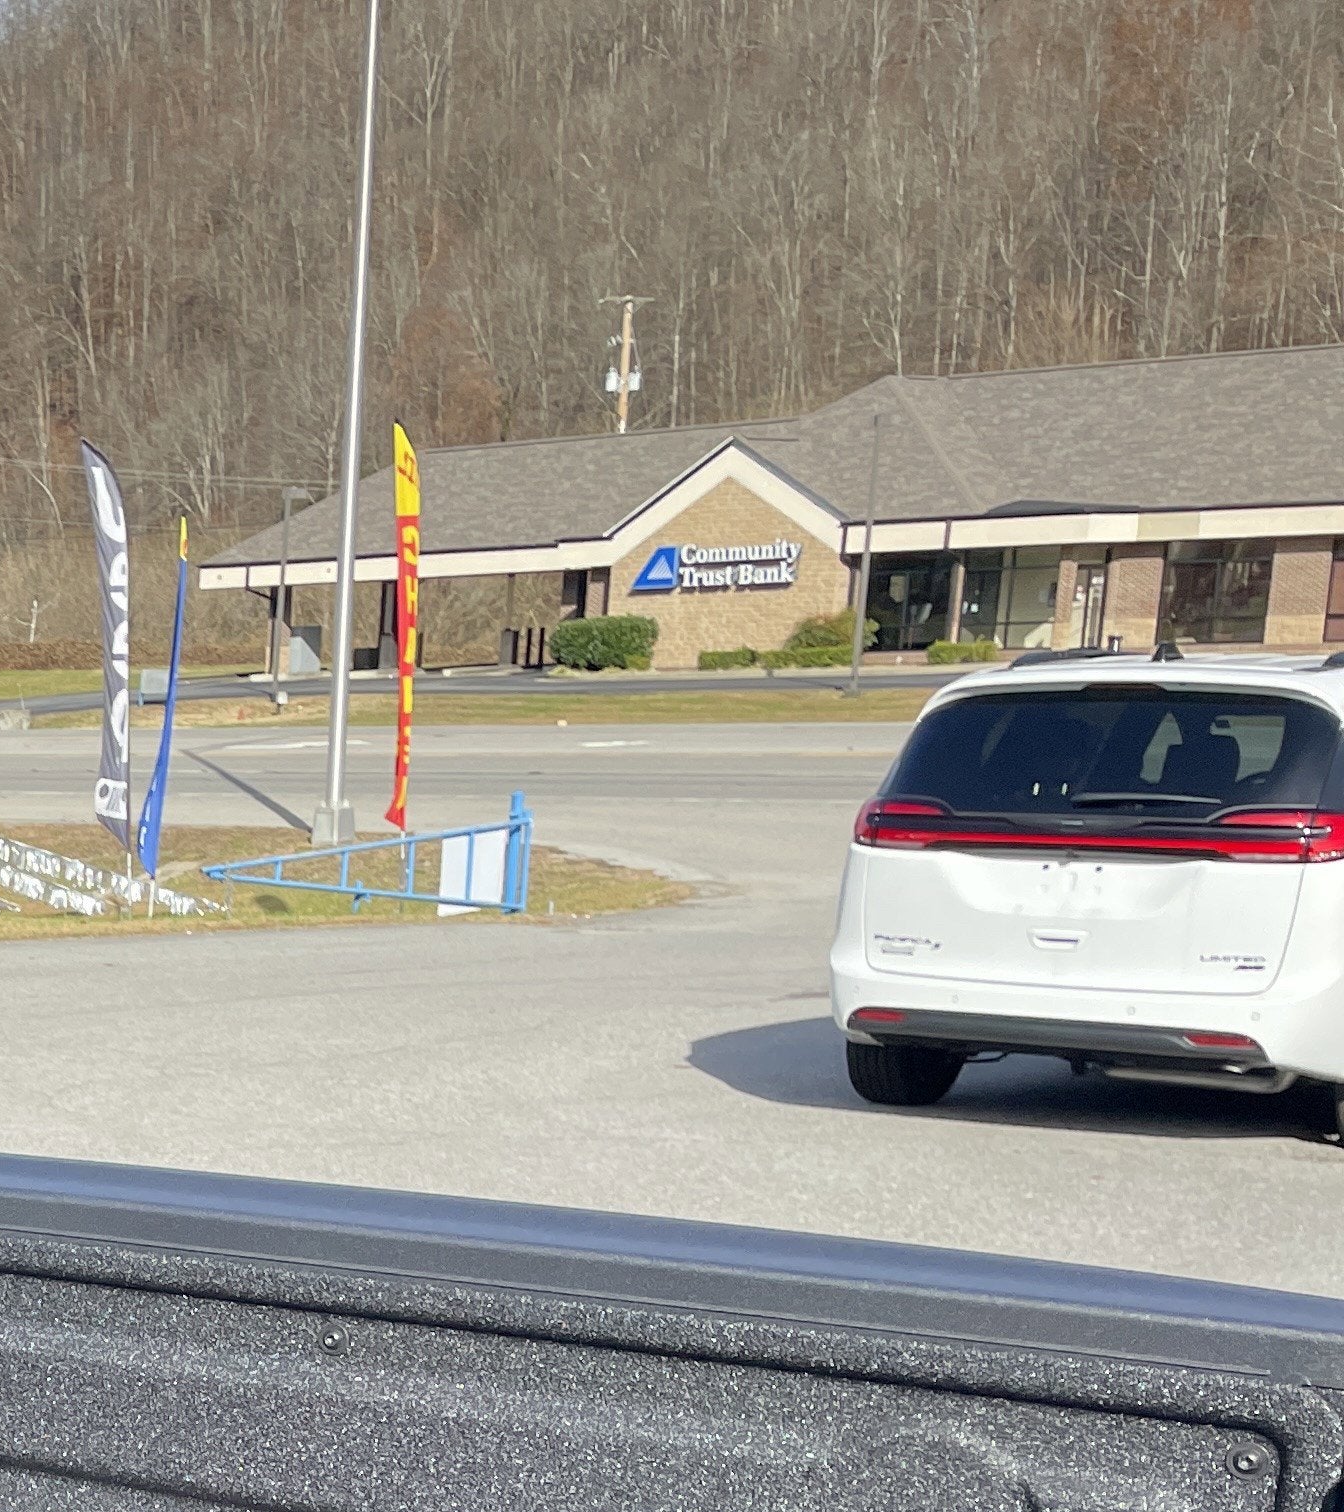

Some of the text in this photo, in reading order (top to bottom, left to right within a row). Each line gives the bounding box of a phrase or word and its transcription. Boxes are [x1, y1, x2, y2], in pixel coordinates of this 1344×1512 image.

[680, 538, 802, 565] Community
[679, 561, 795, 588] Trust Bank
